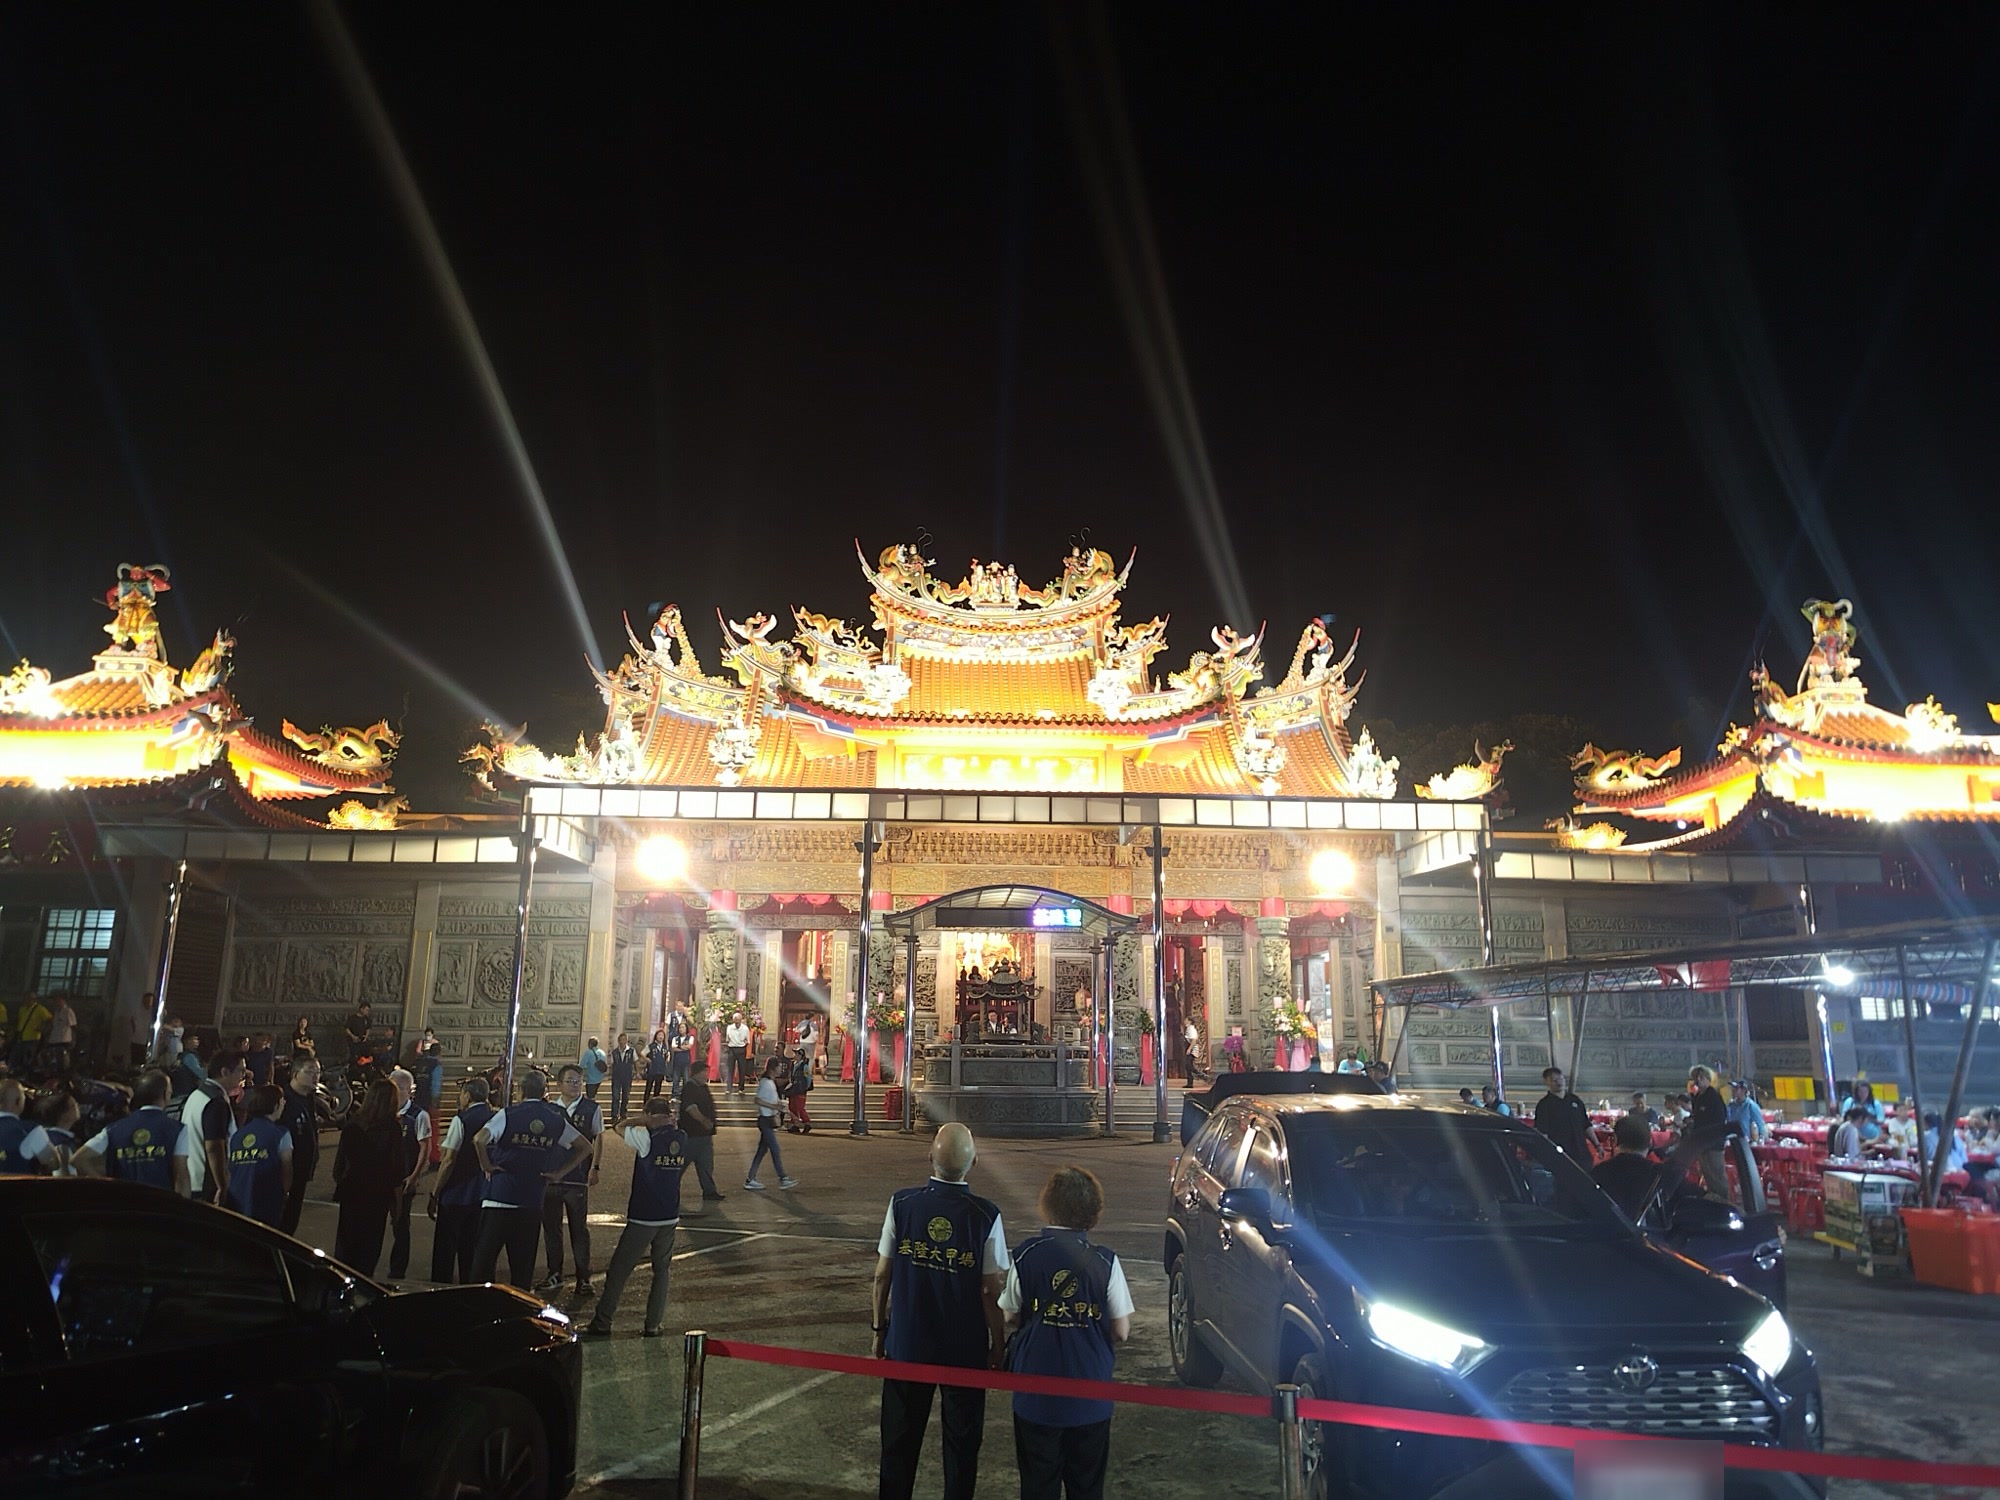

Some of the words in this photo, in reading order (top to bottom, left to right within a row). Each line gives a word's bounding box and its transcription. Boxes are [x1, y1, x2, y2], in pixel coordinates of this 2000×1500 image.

[898, 1238, 976, 1268] 基隆大甲媽
[1032, 1298, 1102, 1320] 隆大甲媽
